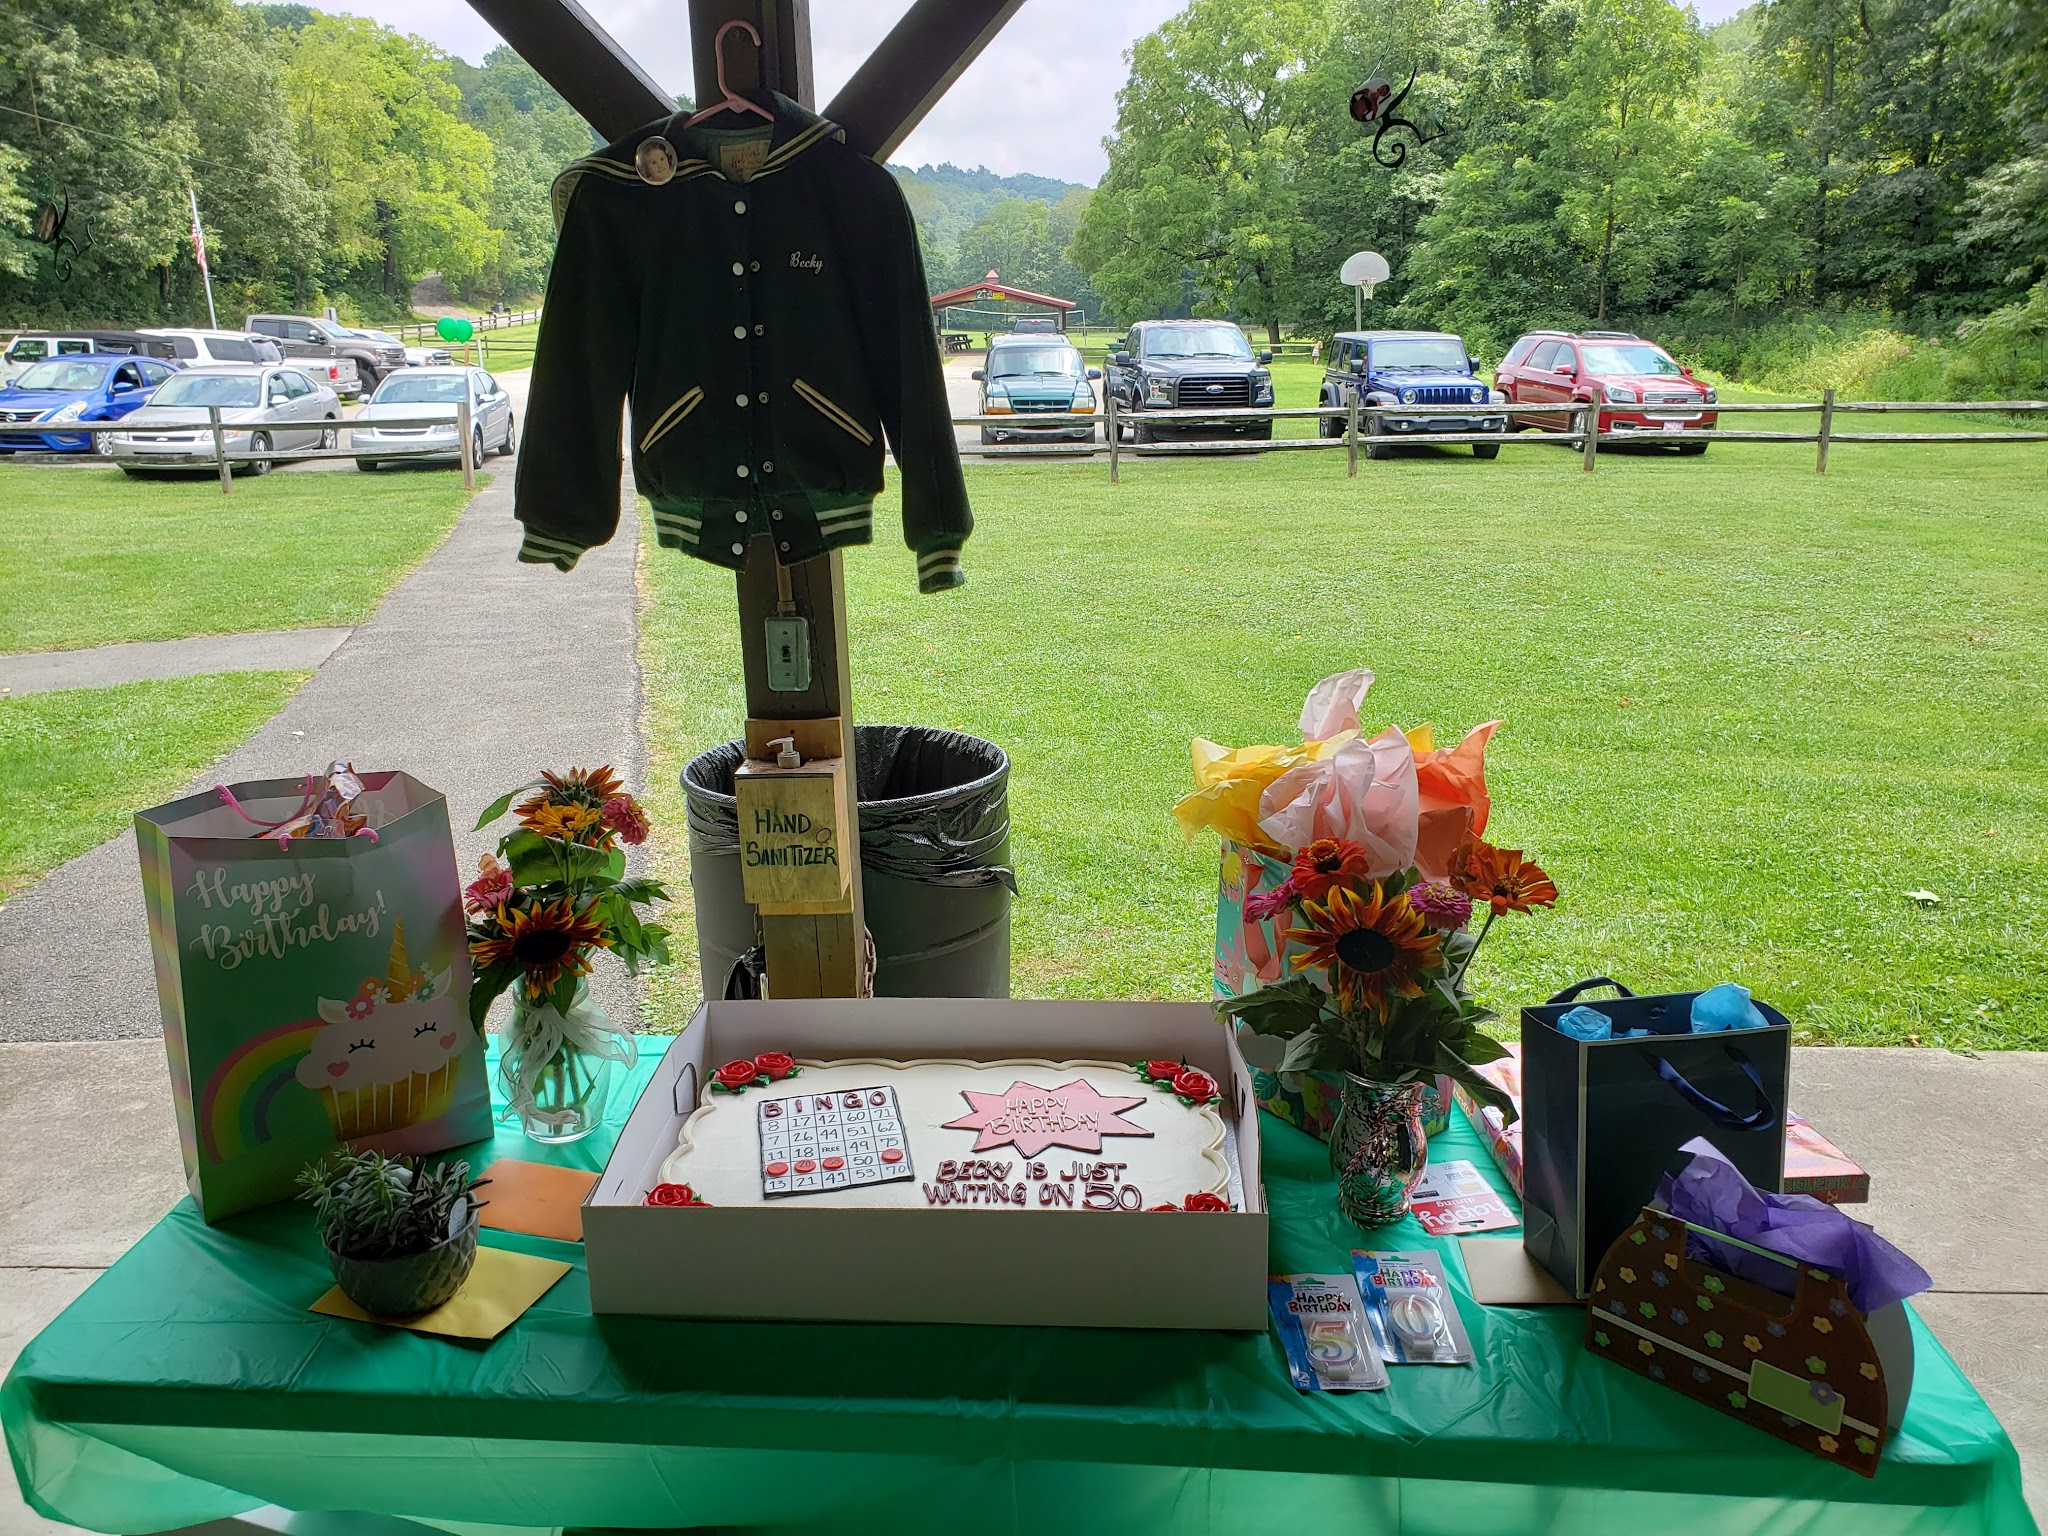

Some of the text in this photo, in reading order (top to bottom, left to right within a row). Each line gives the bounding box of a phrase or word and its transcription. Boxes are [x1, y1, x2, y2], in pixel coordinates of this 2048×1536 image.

[790, 251, 823, 274] Becky
[755, 809, 812, 834] HAND
[746, 841, 838, 867] SANITIZER
[186, 868, 316, 916] Happy
[189, 890, 388, 970] Birthday!
[1005, 1097, 1069, 1116] HAPPY
[768, 1108, 892, 1131] 8 17 42 60 71
[986, 1112, 1100, 1135] BIRTHDAY
[769, 1122, 897, 1145] 7 26 44 51 62
[768, 1150, 787, 1161] 11
[795, 1147, 814, 1158] 18
[850, 1141, 869, 1152] 49
[880, 1137, 898, 1148] 75
[854, 1156, 873, 1165] 50
[769, 1165, 906, 1190] 13 21 41 53 70
[936, 1160, 1127, 1181] BECKY IS JUST
[922, 1182, 1142, 1210] WAITING ON 50
[1436, 1197, 1476, 1207] dining
[1418, 1200, 1512, 1227] happy
[1288, 1302, 1351, 1313] BIRTHDAY
[1296, 1292, 1343, 1303] HAPPY
